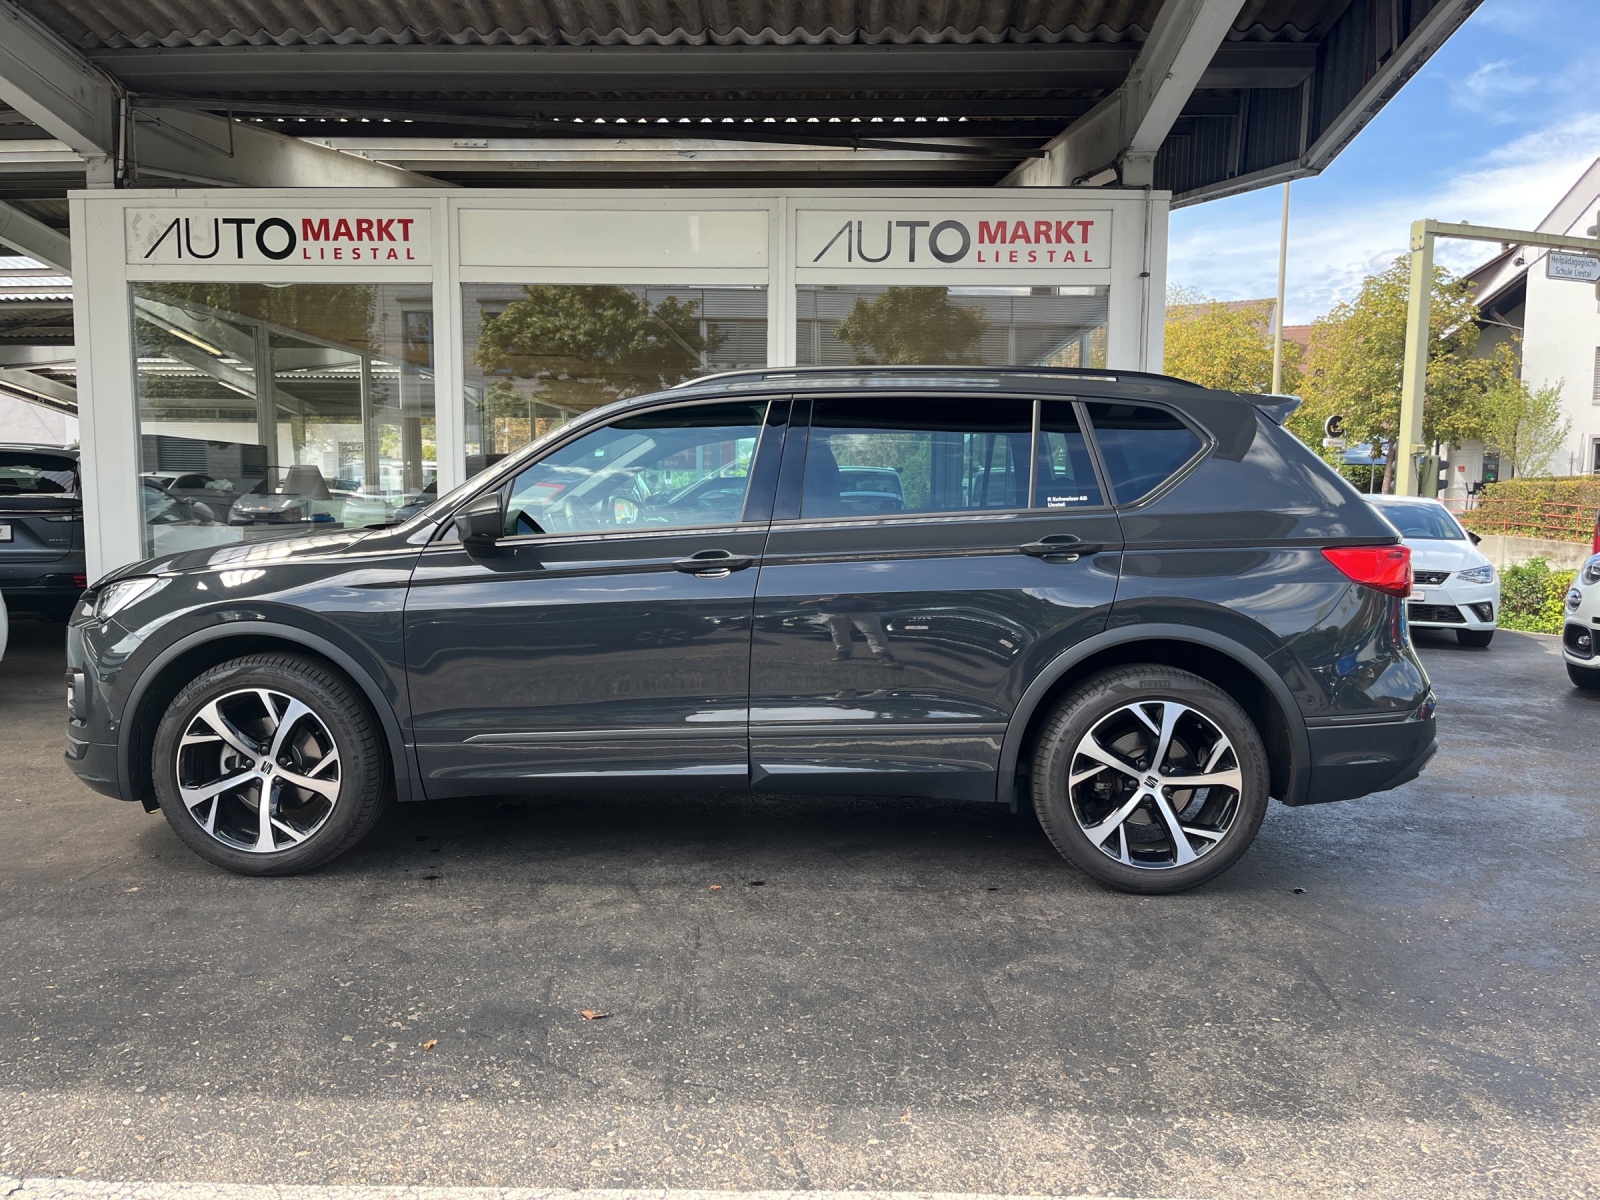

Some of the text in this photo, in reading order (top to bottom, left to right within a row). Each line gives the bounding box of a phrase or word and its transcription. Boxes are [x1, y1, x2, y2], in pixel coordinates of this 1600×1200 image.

[144, 217, 414, 260] AUTO MARKT
[812, 219, 1094, 263] AUTO MARKT
[303, 247, 415, 260] LIESTAL
[977, 250, 1093, 263] LIESTAL
[1551, 255, 1597, 268] Heilpädagogische
[1555, 266, 1592, 278] Schule Liestal
